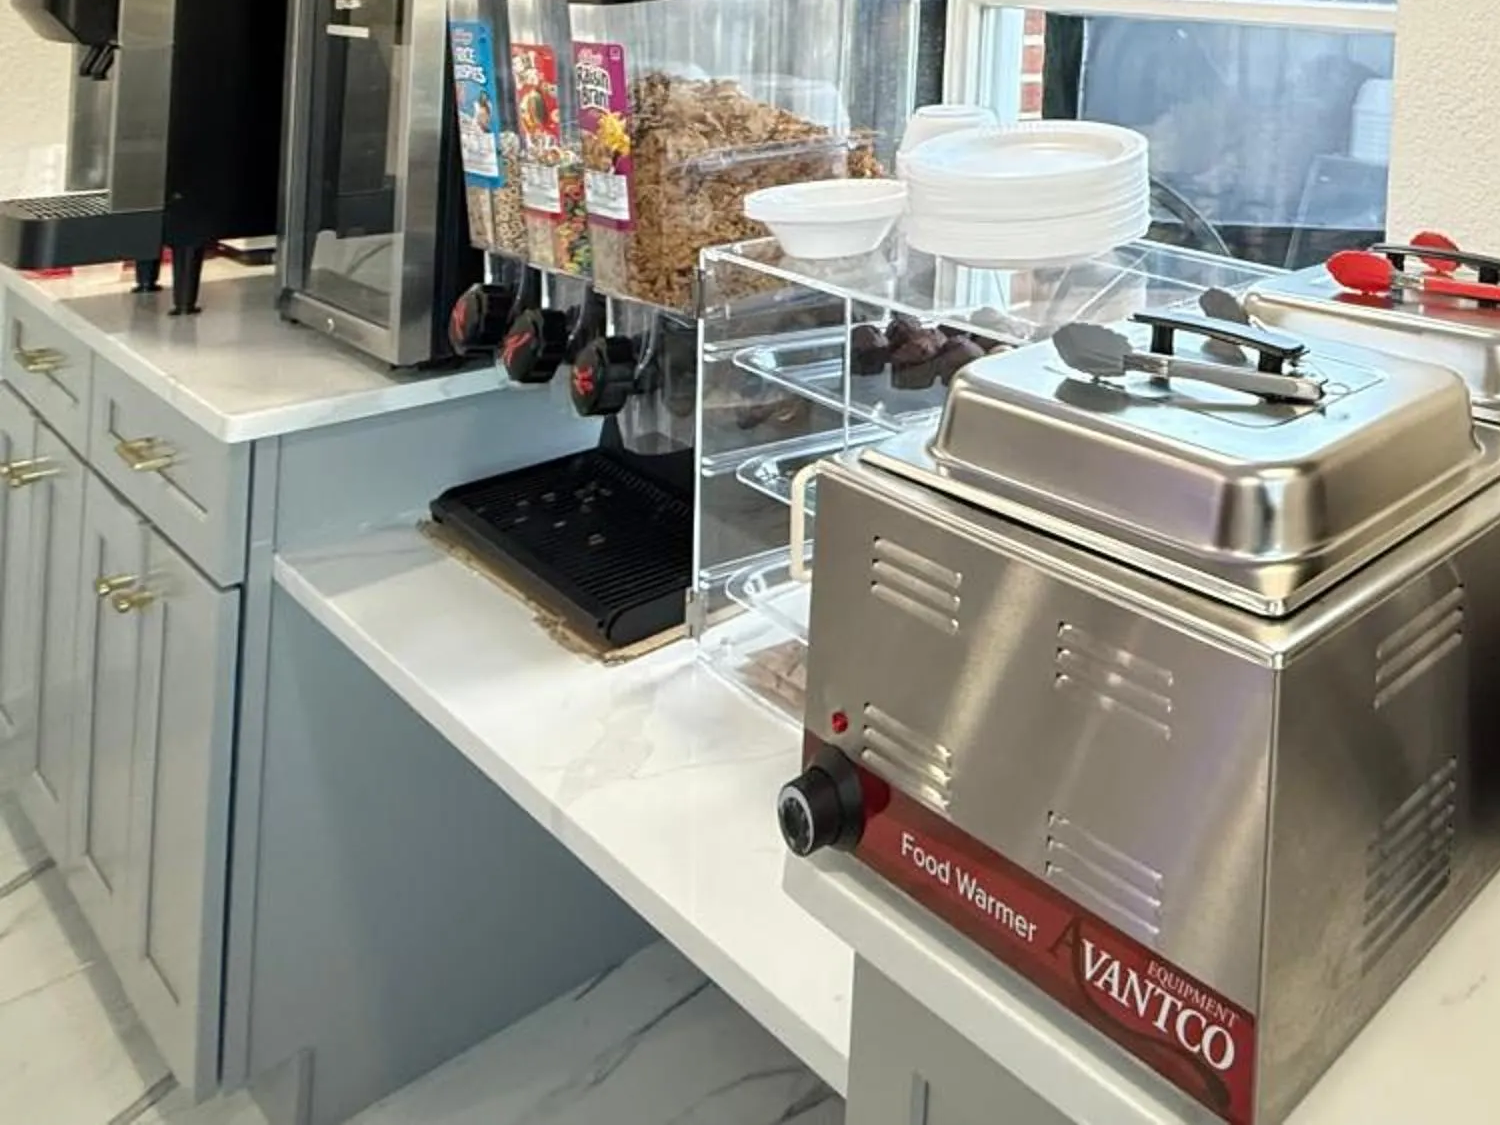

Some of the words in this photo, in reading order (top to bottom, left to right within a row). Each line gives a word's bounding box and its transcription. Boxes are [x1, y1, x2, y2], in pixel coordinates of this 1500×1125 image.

[901, 831, 951, 887] Food
[955, 867, 1038, 944] Warmer
[1146, 958, 1240, 1028] EQUIPMENT
